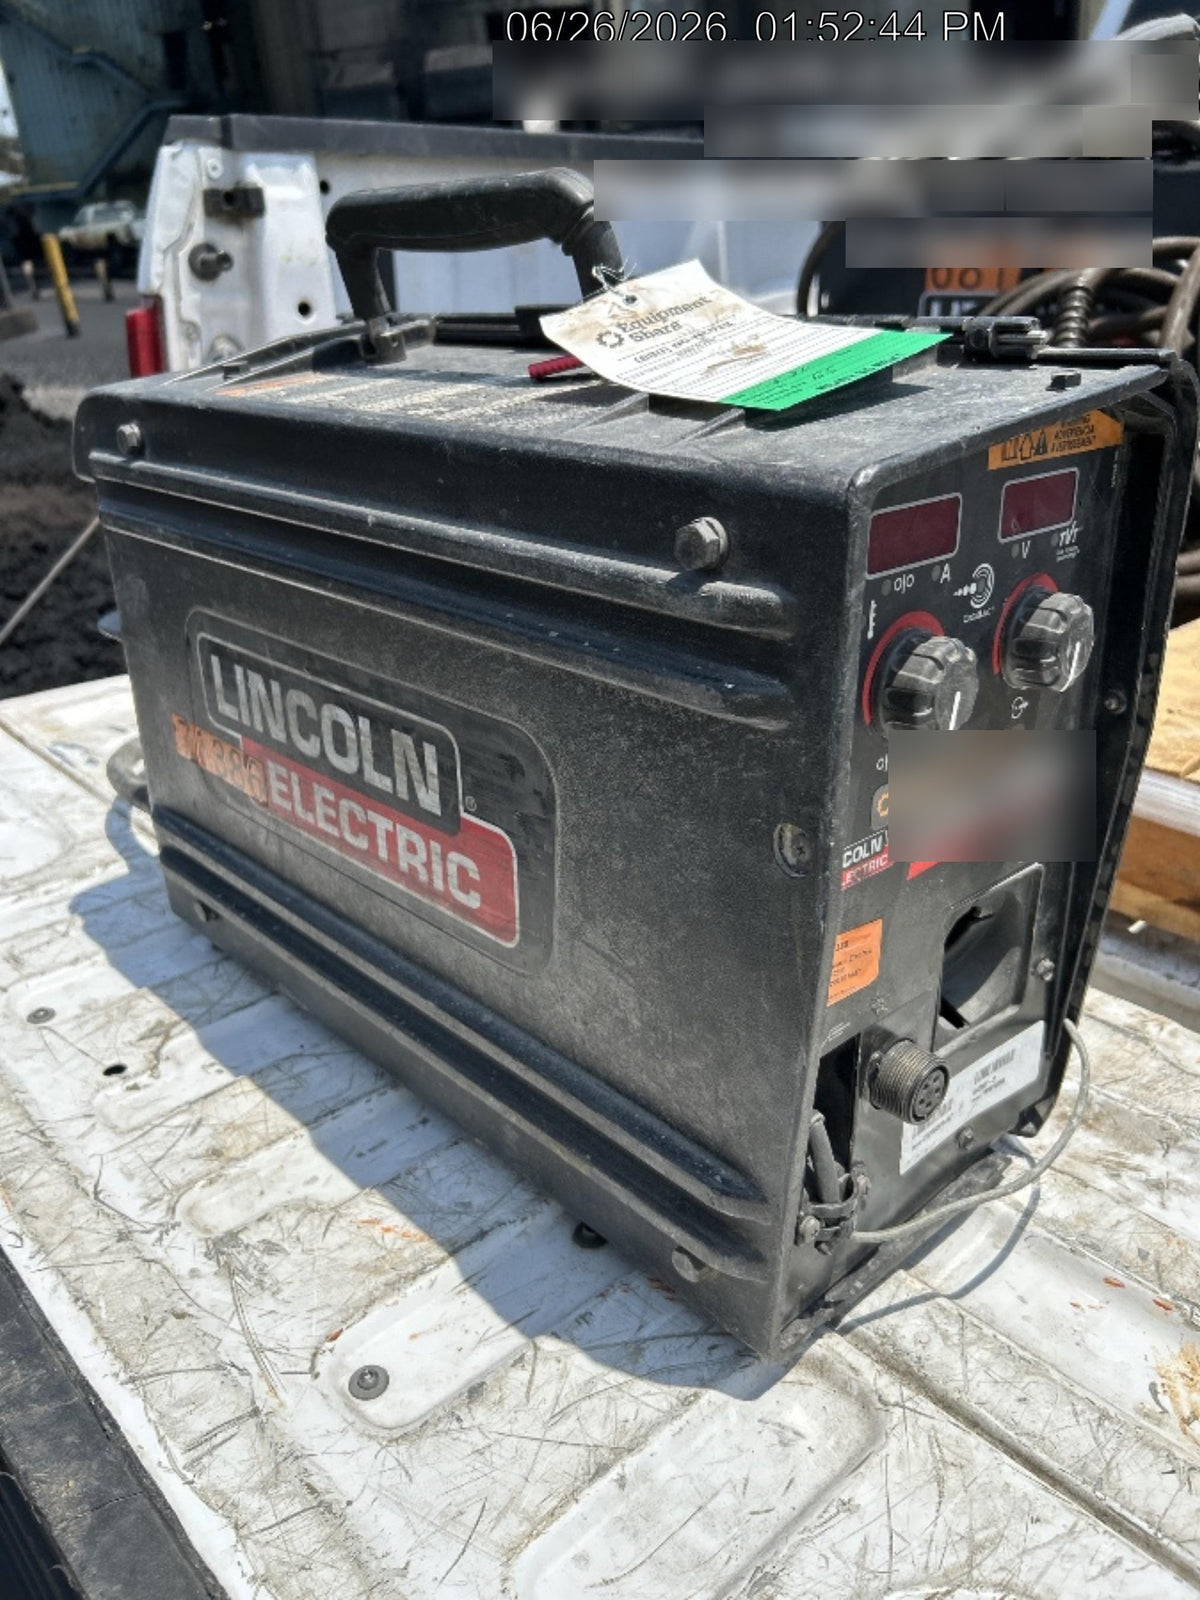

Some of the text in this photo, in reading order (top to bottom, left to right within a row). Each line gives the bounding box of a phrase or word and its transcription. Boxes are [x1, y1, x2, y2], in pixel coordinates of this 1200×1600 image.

[616, 295, 712, 333] Equipment
[629, 320, 683, 342] Share
[1021, 540, 1031, 559] V
[940, 563, 951, 584] A
[210, 653, 442, 816] LINCOLN
[266, 761, 482, 911] ELECTRIC
[841, 854, 889, 887] ECTRIC
